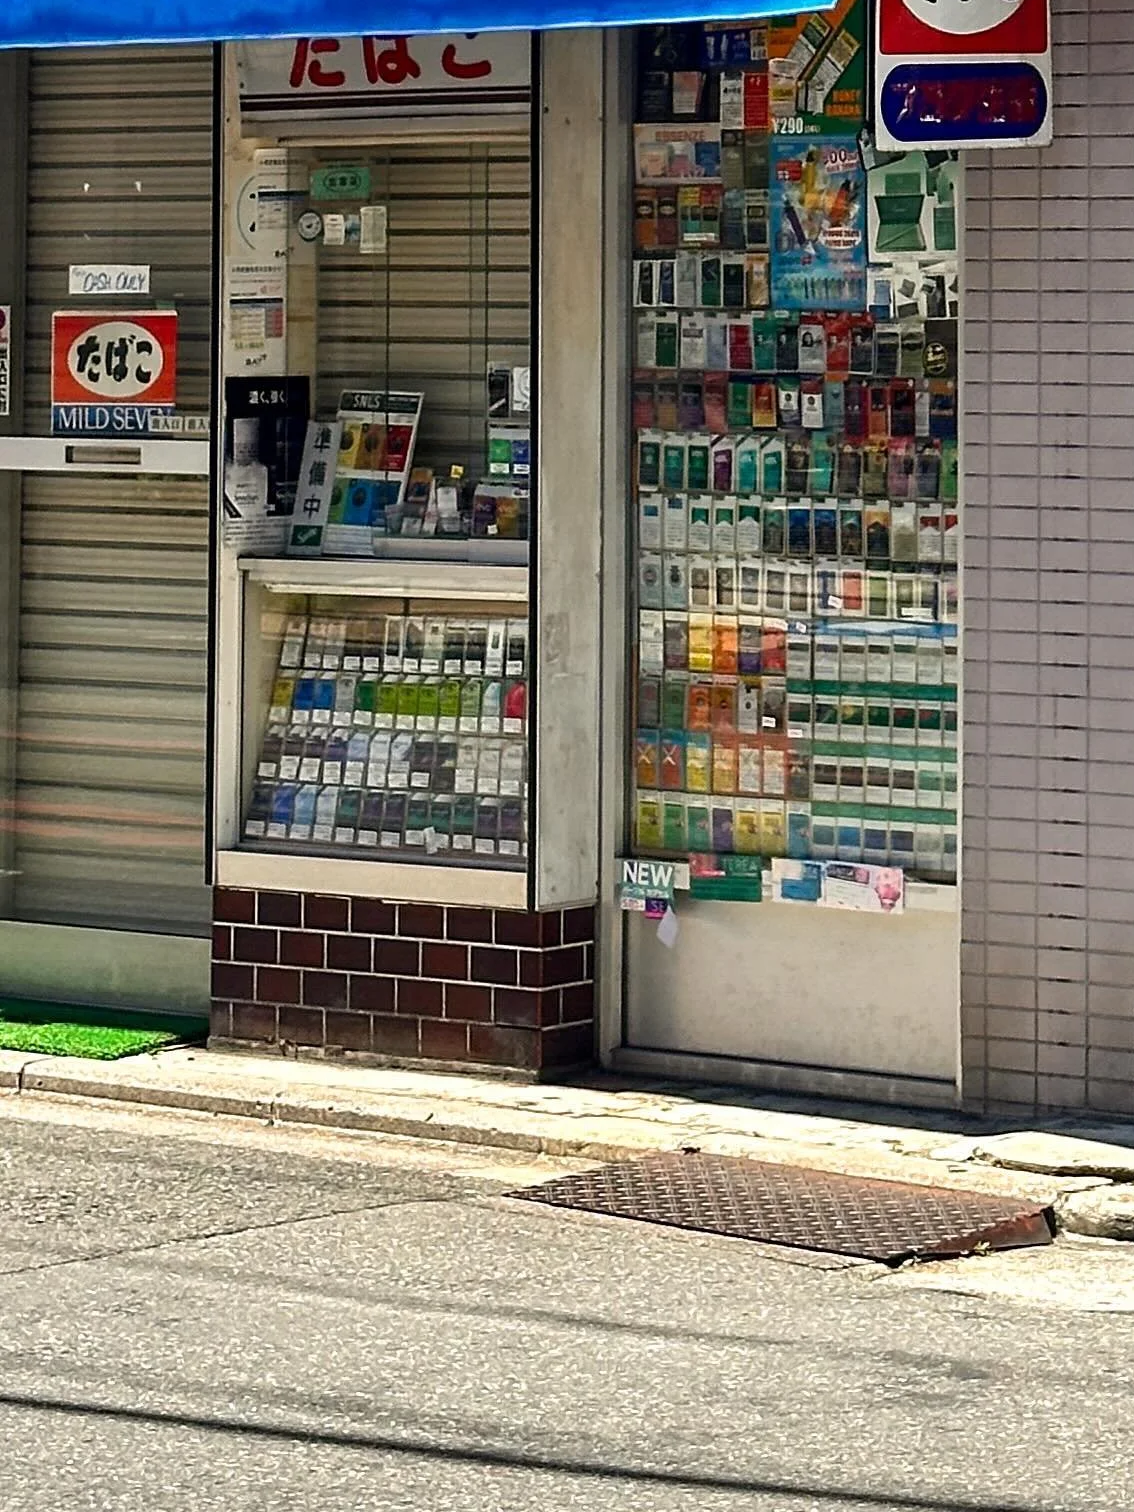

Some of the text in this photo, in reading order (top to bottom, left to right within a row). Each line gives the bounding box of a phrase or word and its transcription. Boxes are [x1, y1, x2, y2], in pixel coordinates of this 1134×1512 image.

[76, 334, 153, 384] たばこ
[58, 407, 110, 430] MILD
[113, 406, 171, 431] SEV
[302, 426, 333, 521] 準備中
[622, 861, 673, 887] NEW
